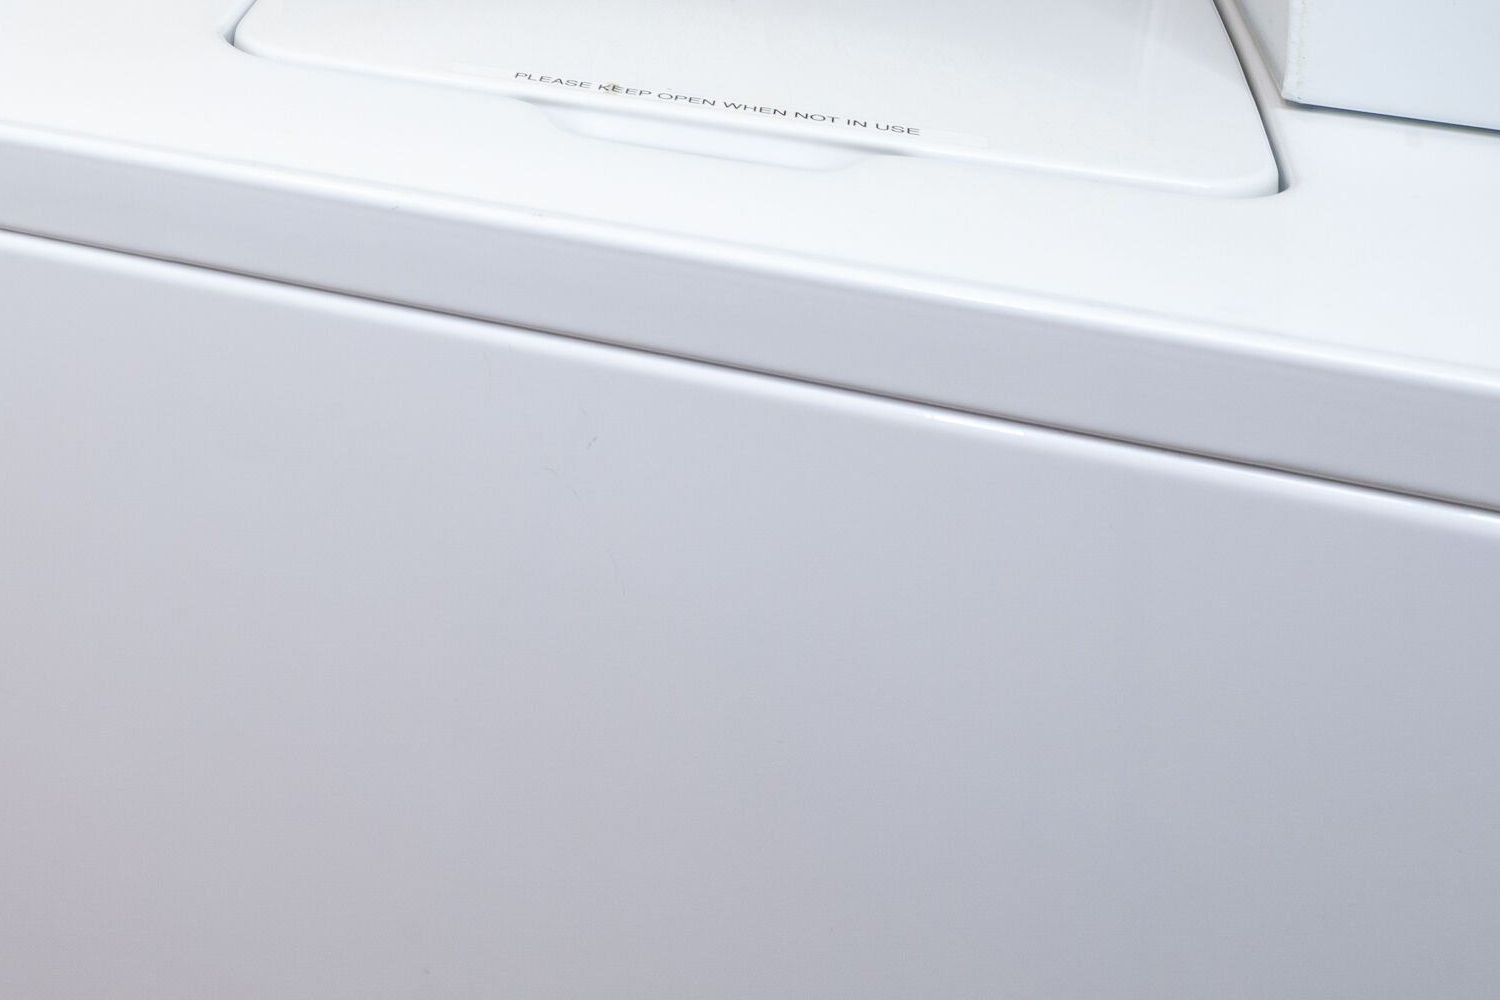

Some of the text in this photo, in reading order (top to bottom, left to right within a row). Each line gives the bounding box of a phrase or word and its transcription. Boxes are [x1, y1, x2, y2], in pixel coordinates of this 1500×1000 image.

[514, 72, 921, 136] PLEASE KEEP OPEN WHEN NOT IN USE
